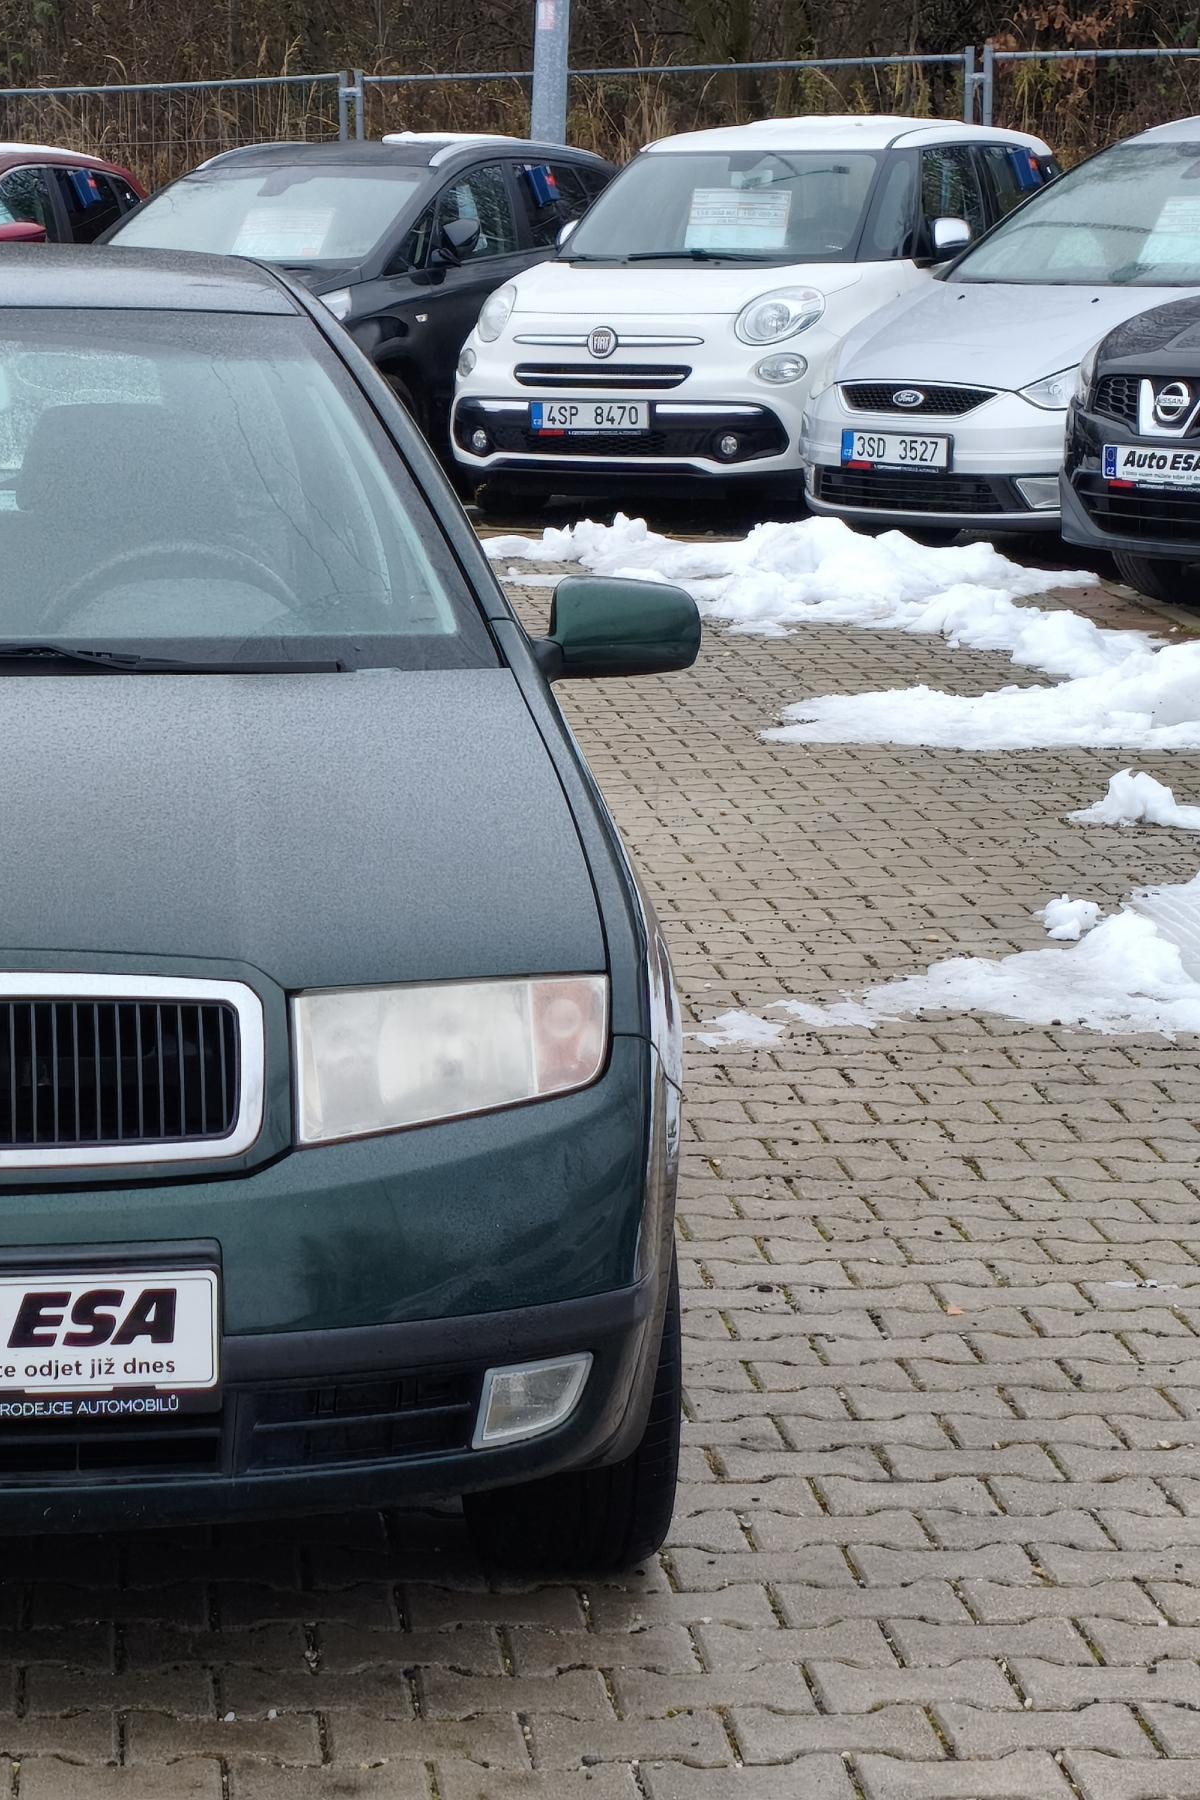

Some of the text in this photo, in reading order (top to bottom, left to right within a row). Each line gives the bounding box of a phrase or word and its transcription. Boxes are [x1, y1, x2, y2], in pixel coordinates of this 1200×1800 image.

[547, 406, 639, 425] 4SP 8470
[857, 436, 939, 462] 3SD 3527
[1123, 450, 1168, 470] Auto
[7, 1288, 177, 1348] ESA
[24, 1360, 83, 1380] odjet
[88, 1358, 116, 1379] již
[123, 1358, 176, 1374] dnes
[76, 1395, 179, 1415] AUTOMOBILŮ
